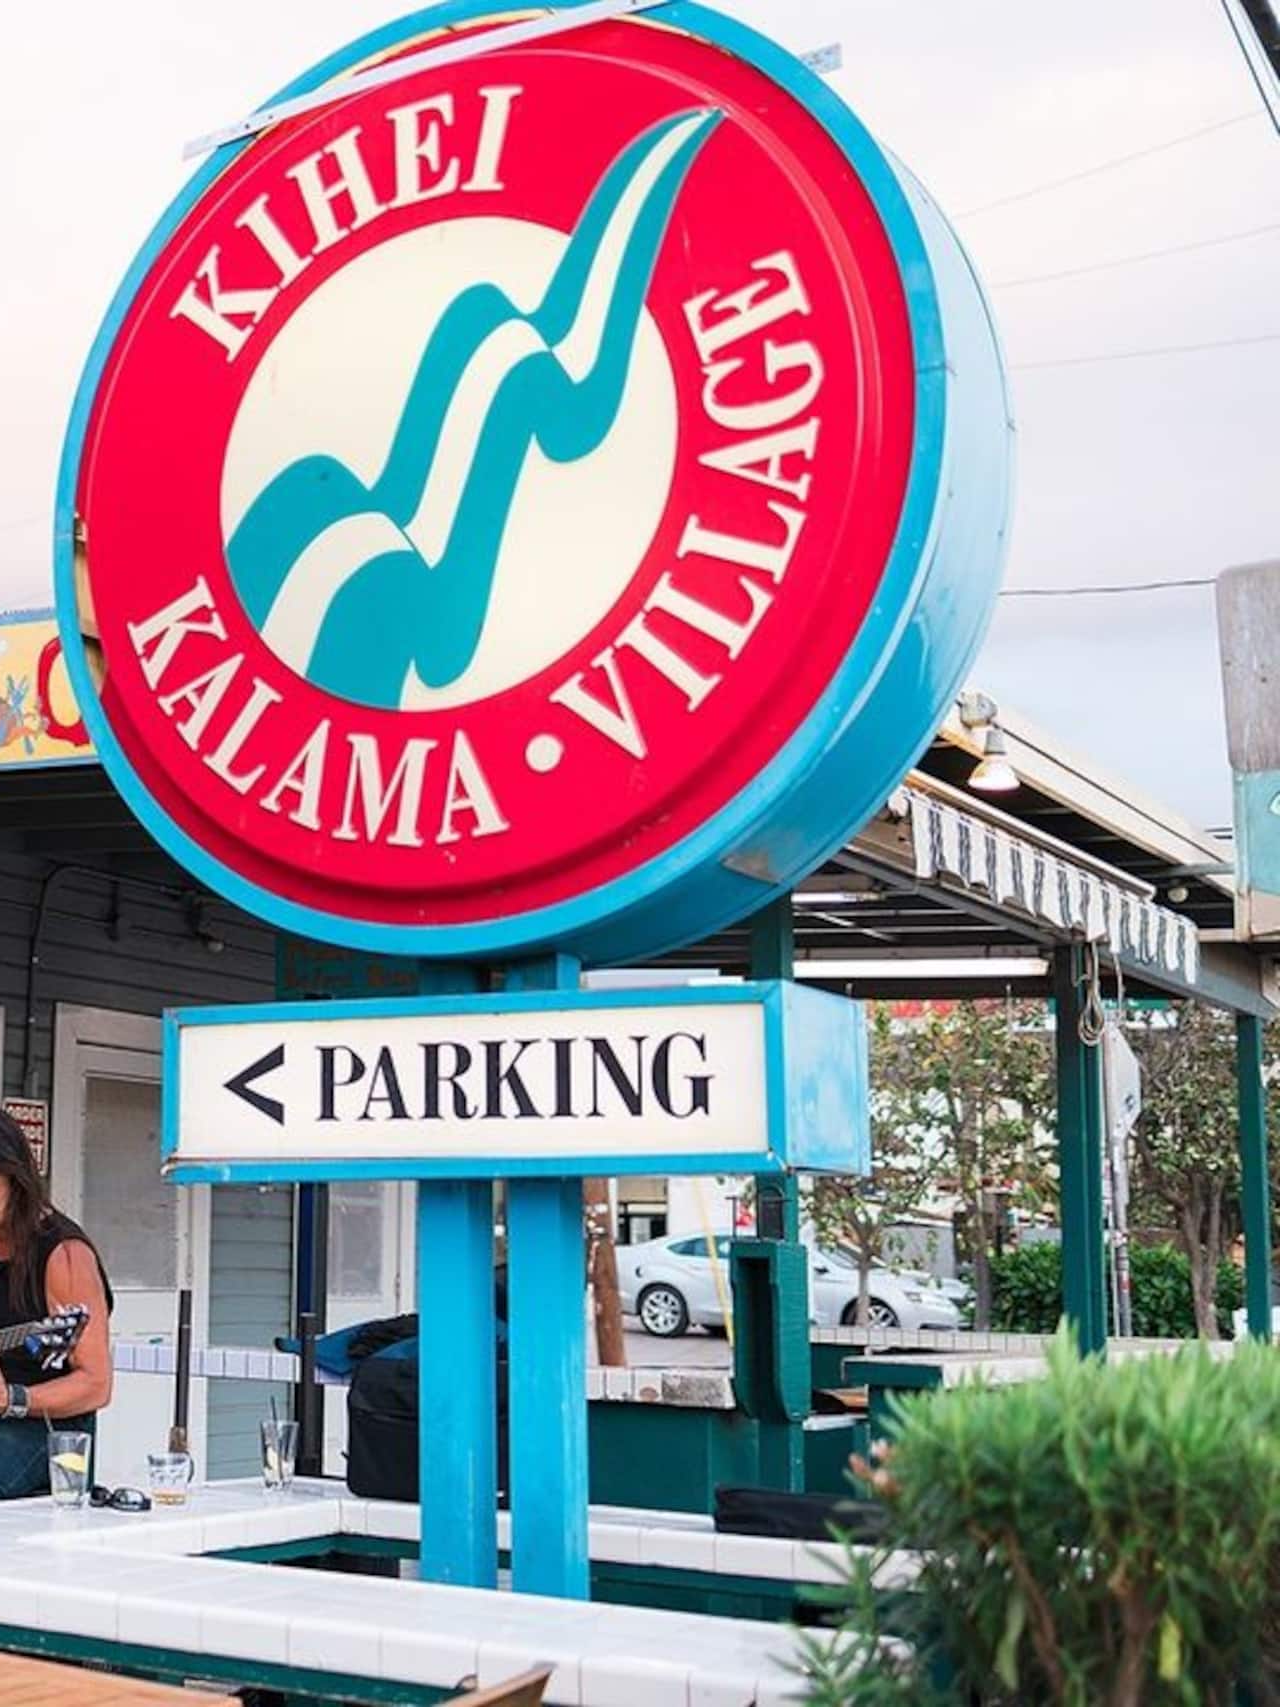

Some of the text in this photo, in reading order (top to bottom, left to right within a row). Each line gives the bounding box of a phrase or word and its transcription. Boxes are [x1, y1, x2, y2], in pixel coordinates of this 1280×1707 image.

[169, 84, 523, 363] KIHEI
[125, 248, 825, 848] KALAMA VILLAGE
[315, 1032, 716, 1122] PARKING
